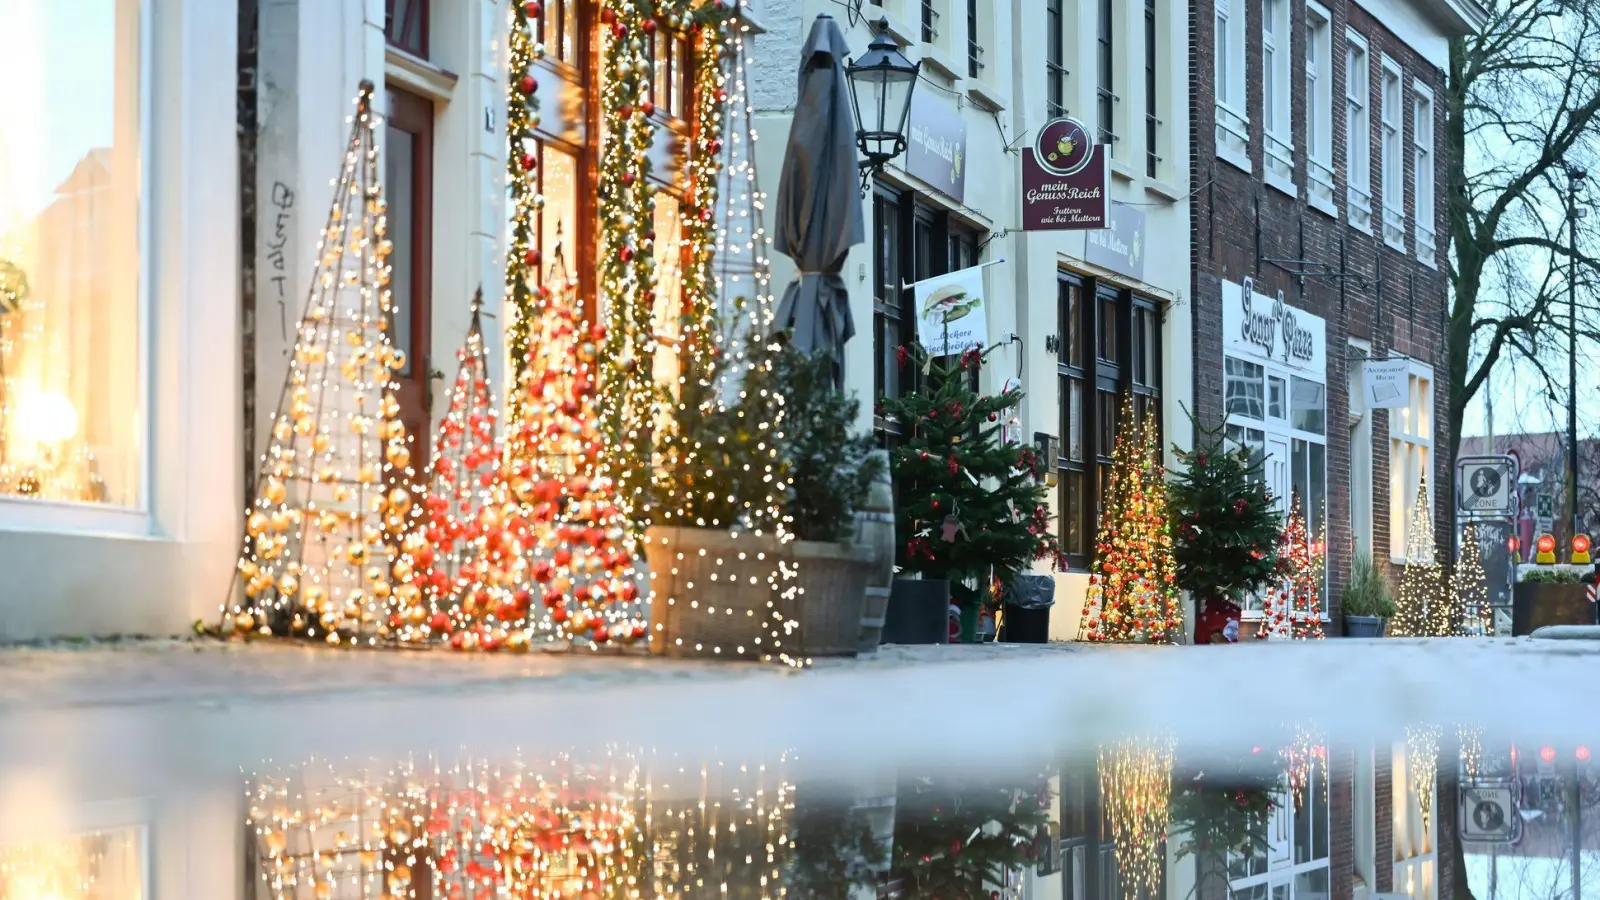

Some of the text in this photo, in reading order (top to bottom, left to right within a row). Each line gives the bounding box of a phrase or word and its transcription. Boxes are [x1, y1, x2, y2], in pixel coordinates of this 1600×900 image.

[1041, 180, 1068, 192] mein
[1053, 206, 1082, 215] Futtern
[1041, 214, 1101, 224] wie bei Muttern
[1282, 306, 1314, 363] Pizza
